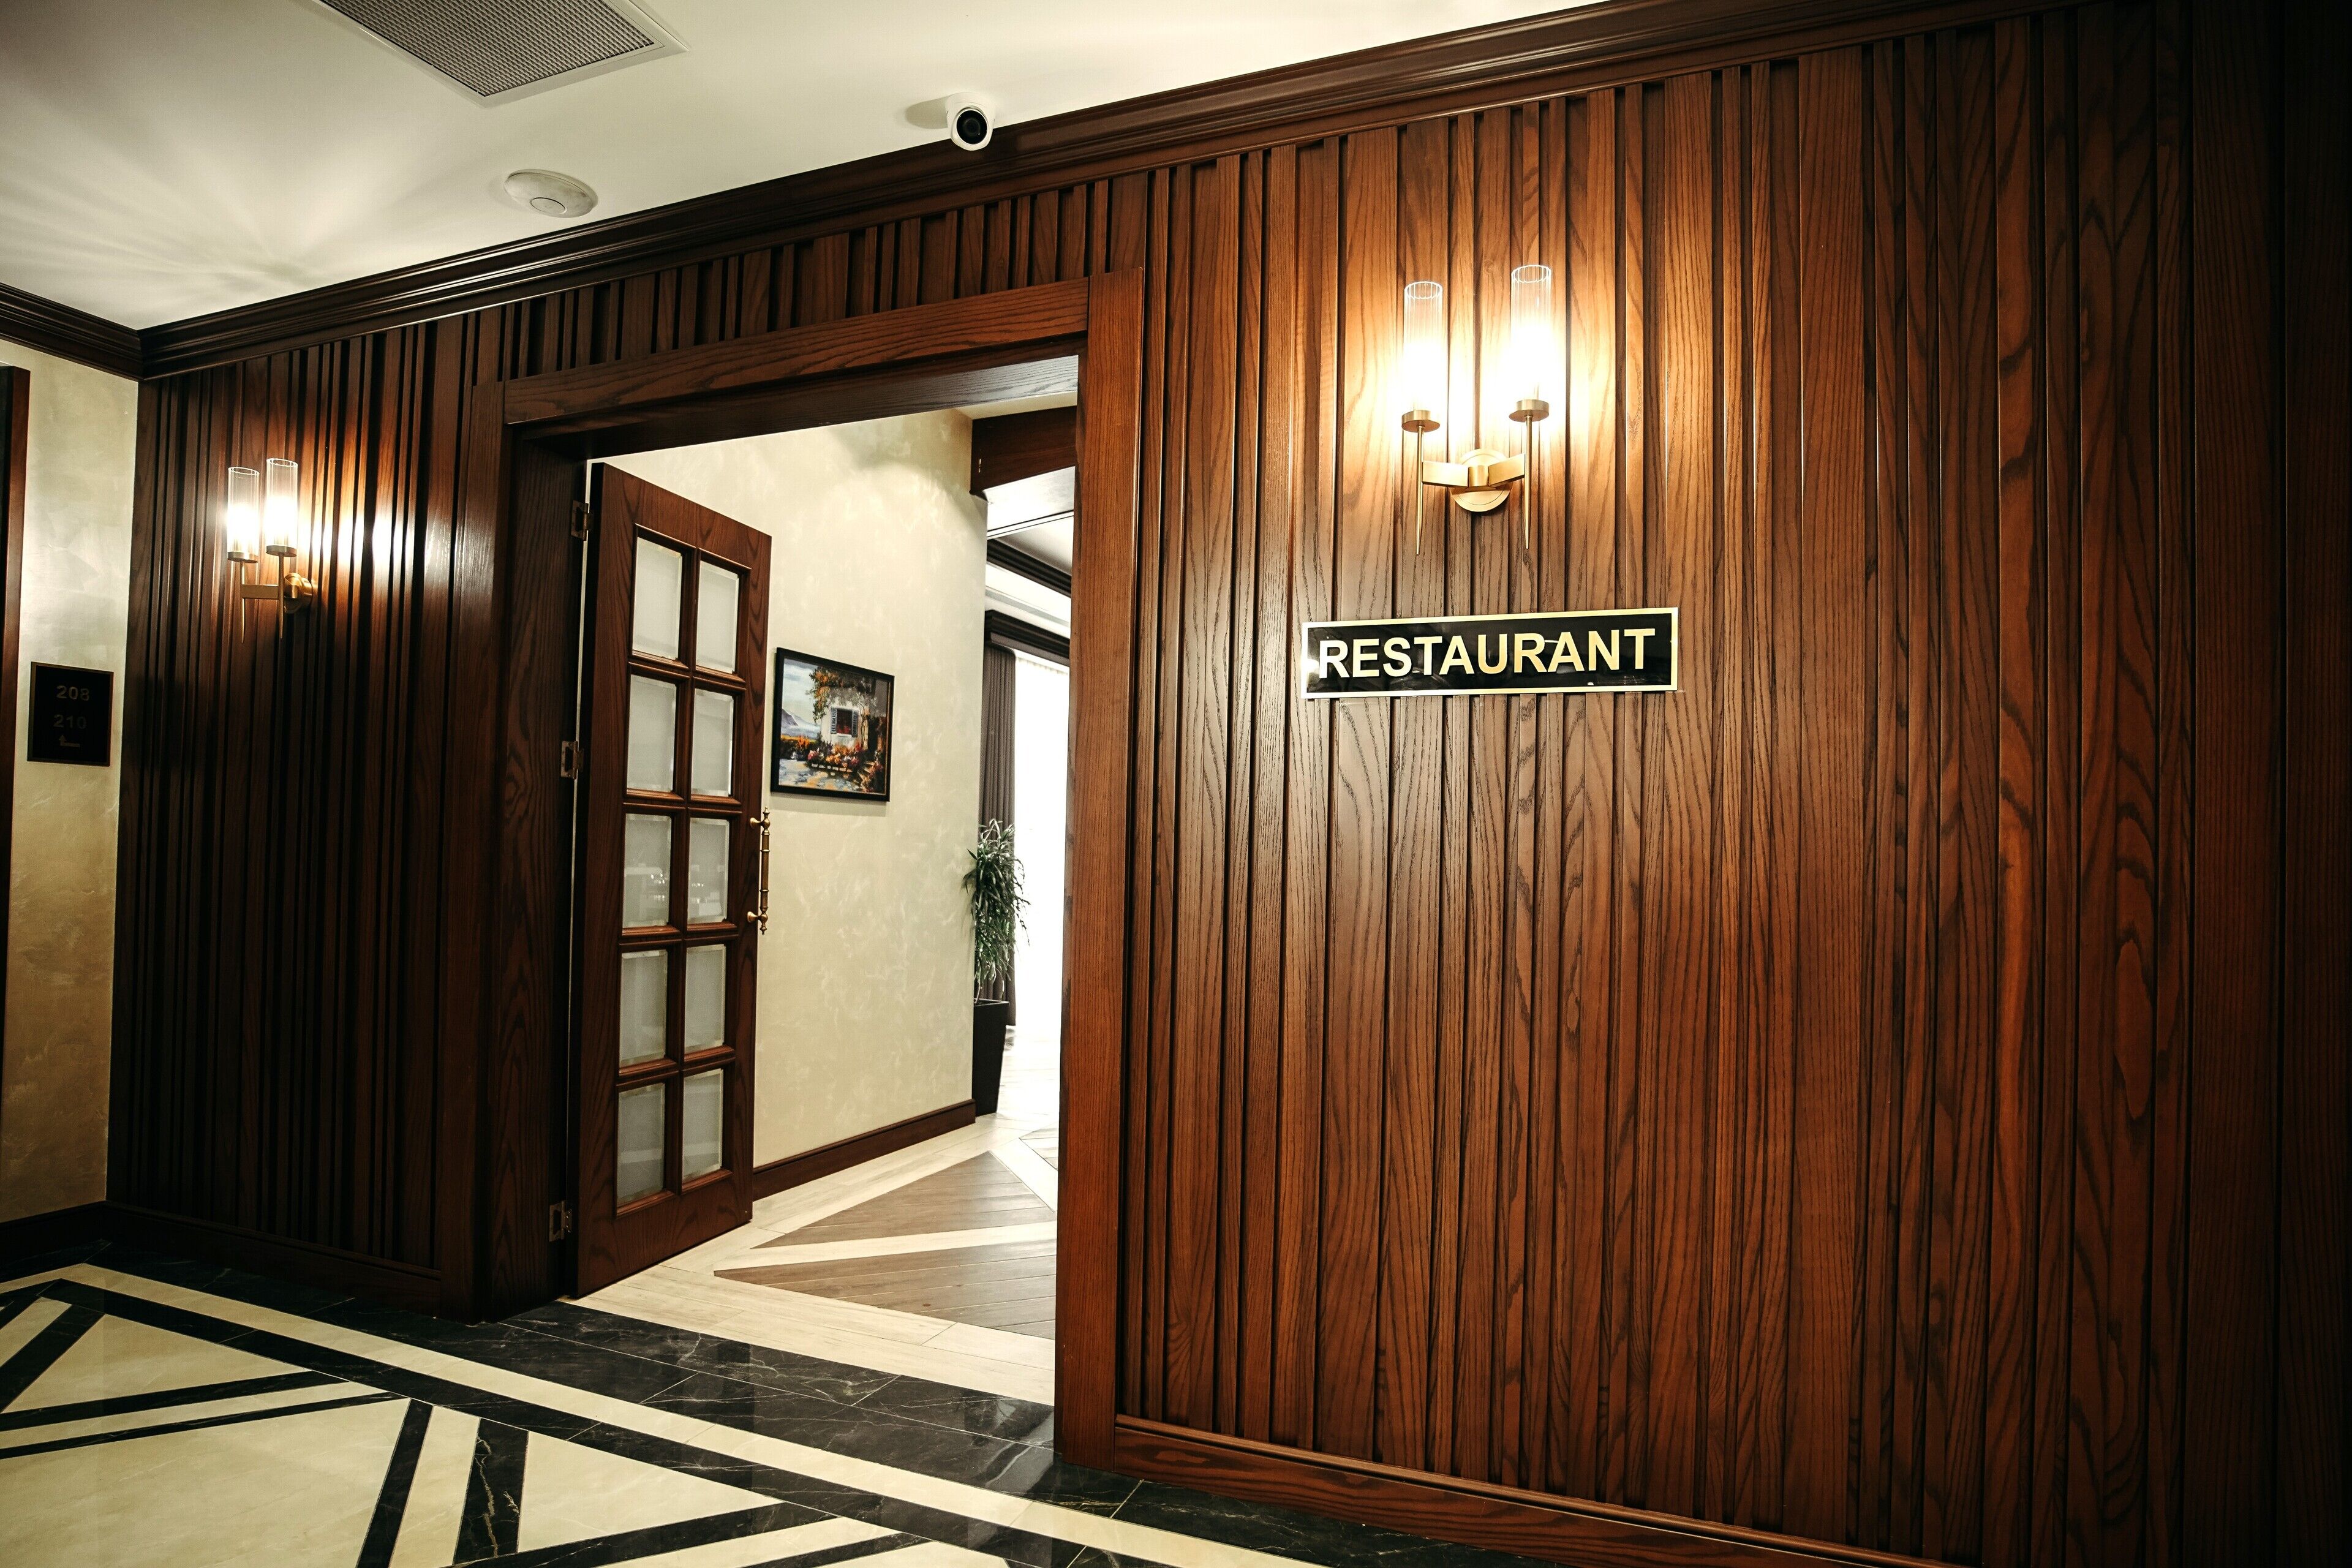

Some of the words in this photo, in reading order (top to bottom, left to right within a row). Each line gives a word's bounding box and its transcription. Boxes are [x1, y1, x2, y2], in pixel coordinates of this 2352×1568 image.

[1319, 628, 1656, 679] RESTAURANT
[56, 685, 89, 701] 208
[53, 714, 86, 729] 210
